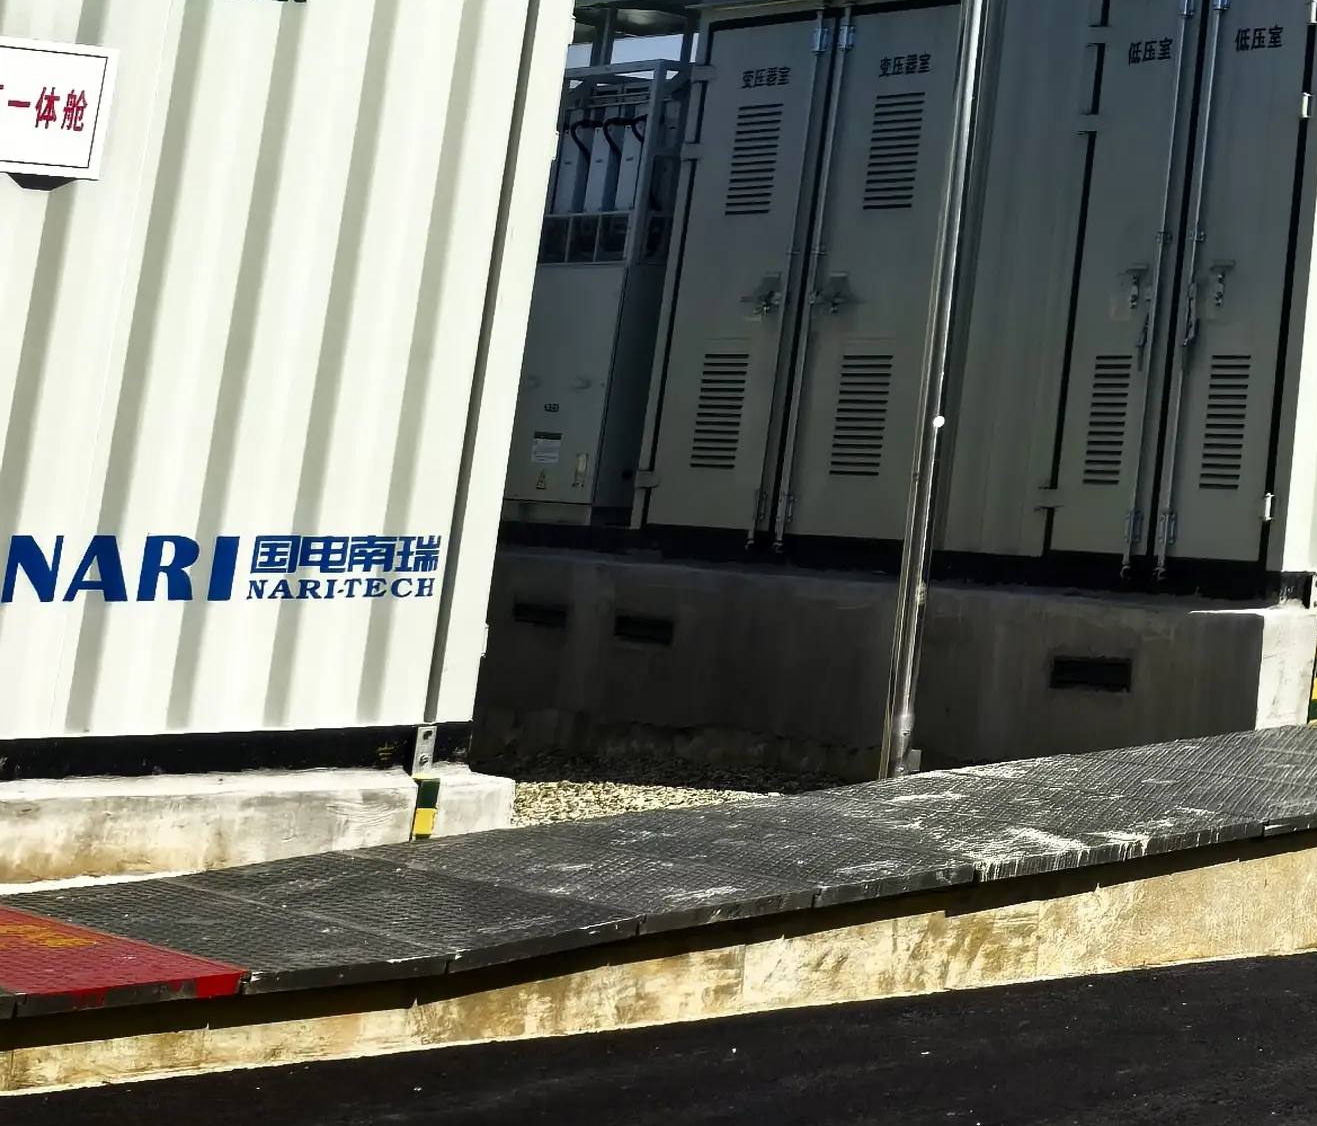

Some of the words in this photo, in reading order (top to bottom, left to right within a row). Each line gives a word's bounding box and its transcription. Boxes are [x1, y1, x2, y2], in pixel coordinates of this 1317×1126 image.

[1128, 37, 1173, 66] 低压室
[1234, 24, 1284, 53] 低压室
[0, 82, 88, 132] 一体舱
[2, 535, 240, 603] NARI
[250, 535, 442, 574] 国电南瑞
[246, 578, 436, 601] NARI-TECH
